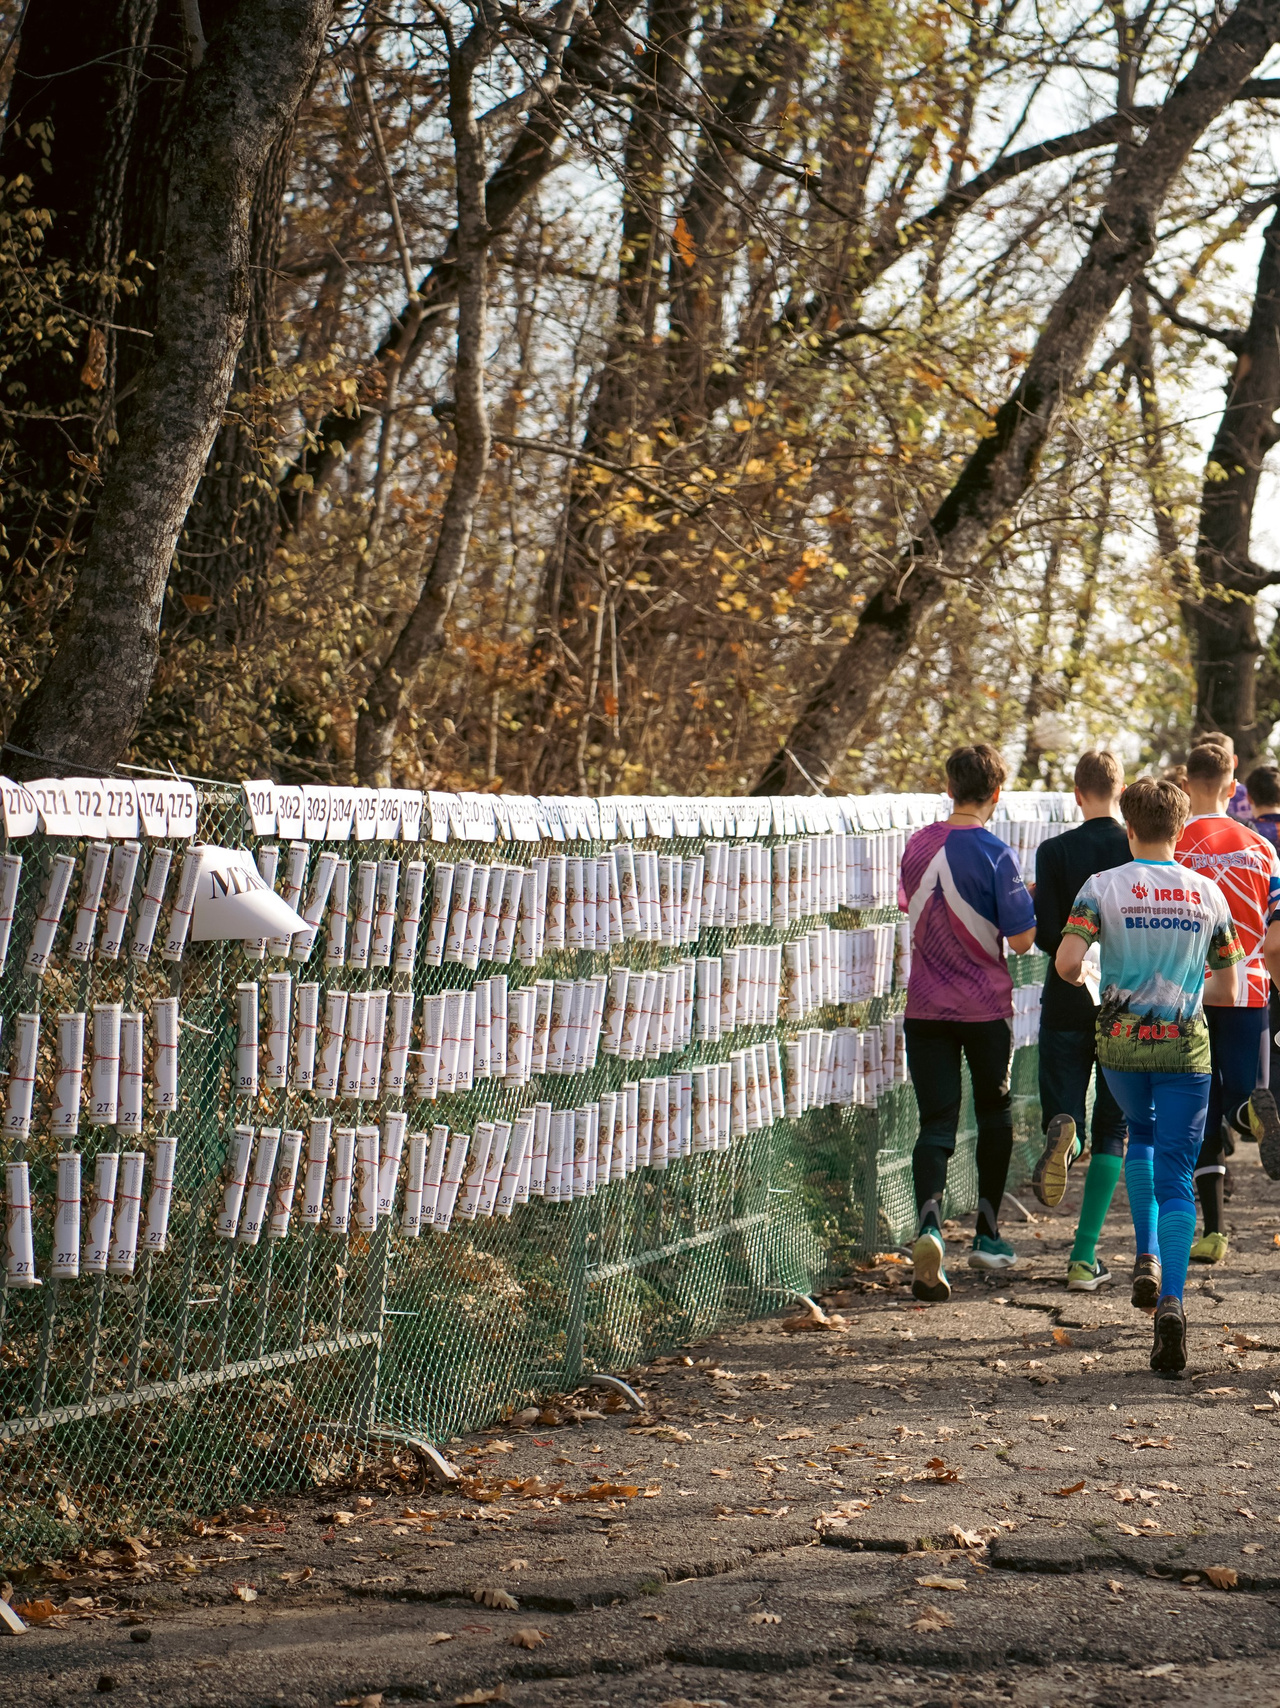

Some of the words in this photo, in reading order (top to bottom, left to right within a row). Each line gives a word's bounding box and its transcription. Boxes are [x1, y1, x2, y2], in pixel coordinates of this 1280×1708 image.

[6, 788, 33, 815] 270
[36, 789, 71, 815] 271
[75, 790, 102, 817] 272
[107, 791, 135, 817] 273
[141, 792, 165, 818] 274
[169, 793, 193, 818] 275
[250, 791, 273, 816] 301
[279, 796, 301, 820] 302
[307, 797, 326, 822] 303
[332, 798, 352, 822] 304
[357, 798, 377, 821] 305
[379, 799, 399, 821] 306
[403, 801, 420, 823] 307
[432, 801, 446, 824] 308
[1154, 888, 1201, 905] IRBIS
[1120, 906, 1184, 916] ORIENTEERING
[1125, 917, 1201, 933] BELGOROD
[76, 941, 90, 951] 27
[106, 940, 120, 951] 27
[31, 953, 47, 965] 27
[1110, 1023, 1131, 1037] 31
[1138, 1024, 1180, 1040] RUS
[302, 1071, 312, 1080] 30
[394, 1076, 404, 1085] 30
[349, 1080, 359, 1089] 30
[163, 1093, 175, 1102] 27
[96, 1103, 116, 1113] 273
[65, 1113, 78, 1123] 27
[307, 1205, 319, 1214] 30
[380, 1199, 391, 1208] 30
[225, 1219, 236, 1229] 30
[247, 1222, 260, 1231] 30
[336, 1216, 346, 1225] 30
[409, 1217, 418, 1225] 30
[58, 1253, 77, 1263] 272
[94, 1250, 109, 1260] 27
